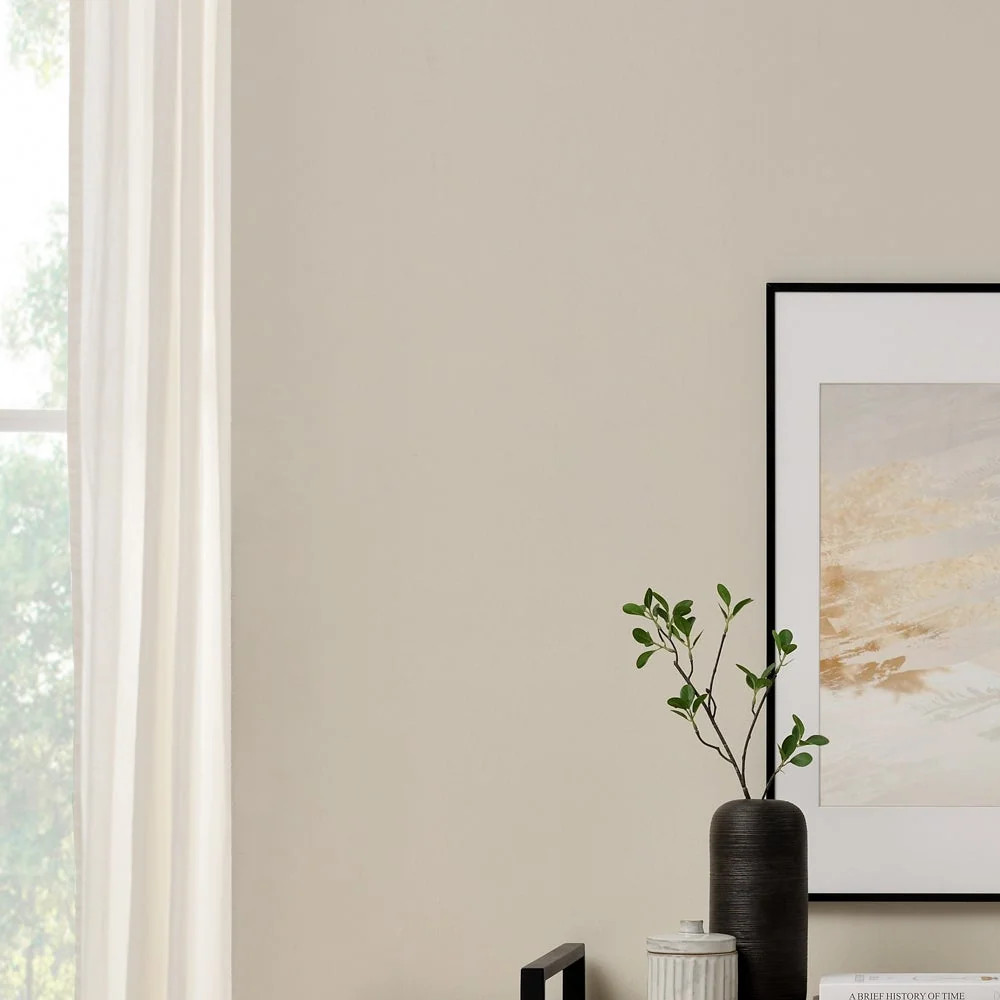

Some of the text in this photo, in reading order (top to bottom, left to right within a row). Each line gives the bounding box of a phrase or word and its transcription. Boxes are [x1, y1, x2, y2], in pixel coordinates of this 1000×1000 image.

[848, 992, 965, 1000] A BRIEF HISTORY OF TIME
